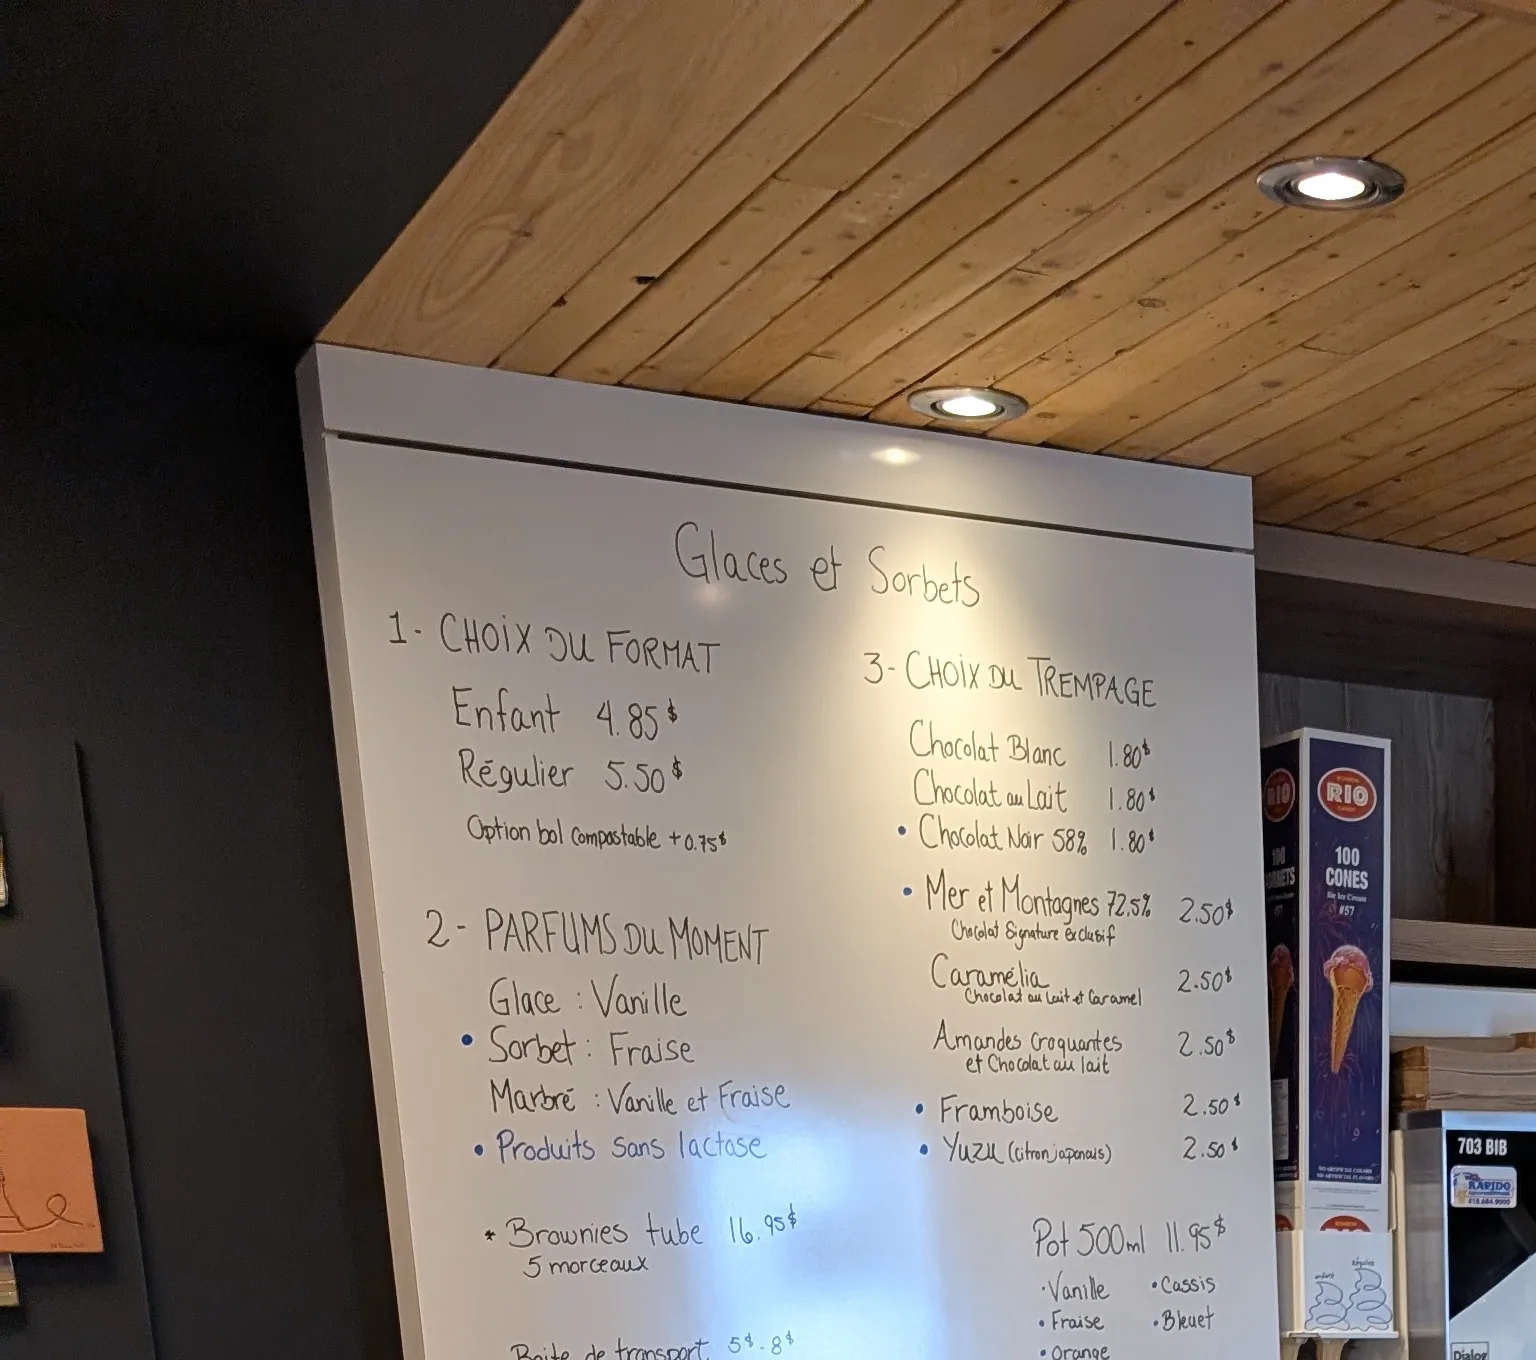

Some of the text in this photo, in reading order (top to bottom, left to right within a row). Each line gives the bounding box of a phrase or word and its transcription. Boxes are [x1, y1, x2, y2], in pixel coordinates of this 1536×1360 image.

[675, 521, 980, 607] Glaces et Sorbets
[546, 626, 594, 663] DU
[608, 629, 720, 673] FORMAT
[989, 664, 1022, 691] DU
[1027, 657, 1156, 707] TREMPAGE
[454, 686, 678, 741] Enfant 4.85$
[909, 719, 1150, 769] Chocolat Blanc 1.80$
[458, 748, 683, 794] Régulier 5.50$
[914, 768, 1155, 813] Chocolat au Lait 1.80$
[1327, 783, 1369, 807] RIO
[468, 815, 530, 844] Option
[538, 818, 563, 846] bol
[919, 813, 1155, 855] Chocolat Noir 58% 1.80$
[1335, 846, 1360, 867] 100
[1326, 867, 1369, 890] CONES
[926, 868, 970, 913] Mer
[978, 881, 995, 912] et
[1002, 873, 1099, 926] Montagnes
[1178, 897, 1233, 927] 2.50$
[486, 908, 616, 955] PARFUMS
[625, 922, 664, 956] DU
[668, 917, 769, 965] MOMENT
[951, 918, 999, 941] Chocolat
[1005, 920, 1059, 950] Signature
[931, 953, 1233, 993] Caramélia 2.50$
[590, 973, 687, 1018] Vanille
[965, 987, 1023, 1005] Chocolat
[1028, 992, 1042, 1003] au
[1073, 989, 1083, 1005] et
[610, 1031, 694, 1066] Fraise
[933, 1019, 1022, 1051] Amandes
[1178, 1028, 1236, 1057] 2.50$
[966, 1053, 1109, 1075] et Chocolat au lait
[608, 1083, 677, 1116] Vanille
[687, 1089, 707, 1114] et
[719, 1079, 790, 1112] Fraise
[941, 1093, 1241, 1124] Framboise 2.50$
[496, 1129, 595, 1164] Produits
[612, 1136, 665, 1160] sans
[943, 1132, 1004, 1164] Yuzu
[1183, 1135, 1239, 1160] 2.50$
[1458, 1137, 1507, 1156] 703 BIB
[1469, 1181, 1511, 1190] RAPIDO
[506, 1216, 628, 1248] Brownies
[646, 1212, 704, 1247] tube
[1032, 1218, 1069, 1258] Pot
[1077, 1222, 1145, 1256] 500ml
[523, 1255, 649, 1279] 5 morceaux
[1161, 1275, 1216, 1294] Cassis
[1048, 1270, 1110, 1302] Vanille
[1052, 1310, 1104, 1330] Fraise
[1162, 1305, 1214, 1331] Bleuet
